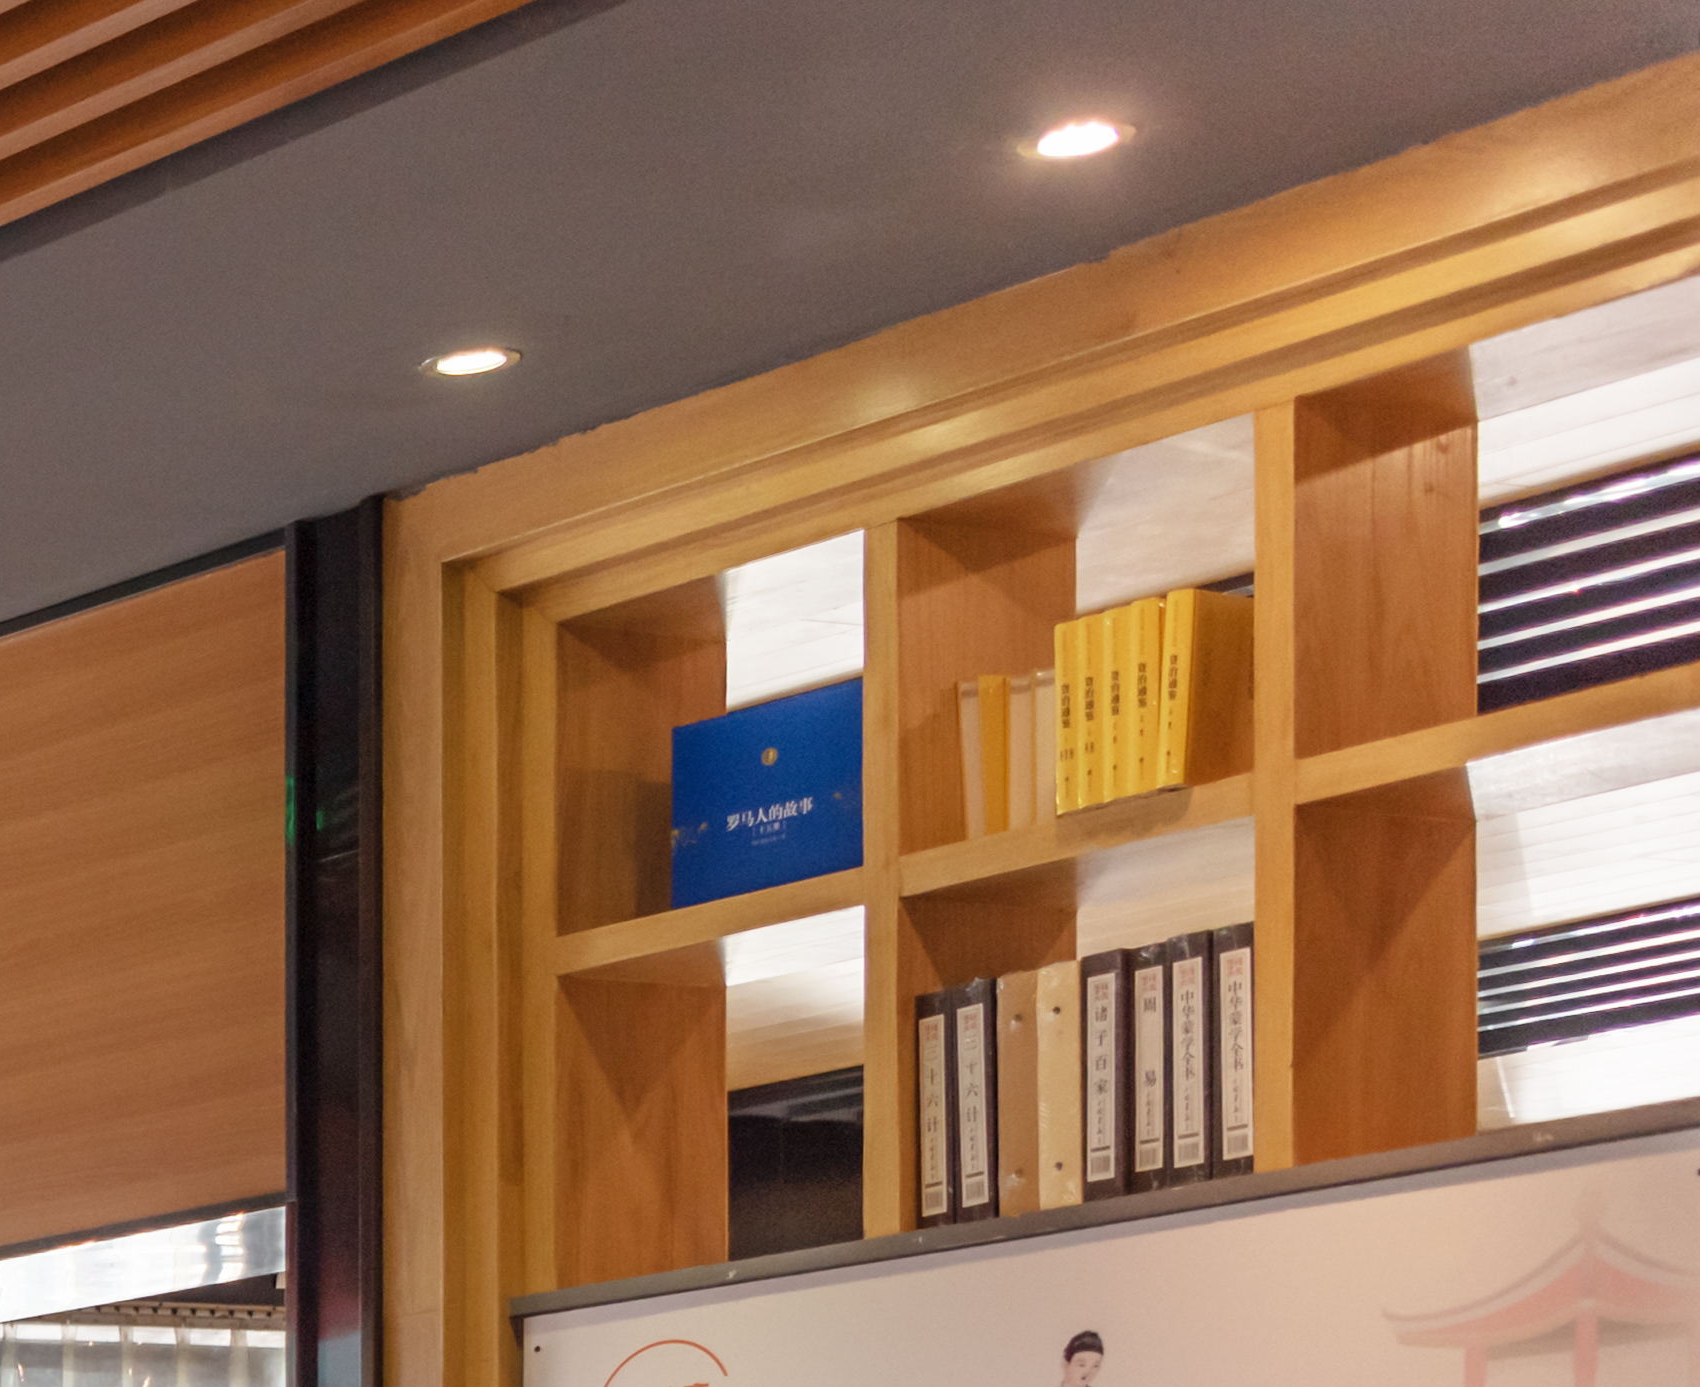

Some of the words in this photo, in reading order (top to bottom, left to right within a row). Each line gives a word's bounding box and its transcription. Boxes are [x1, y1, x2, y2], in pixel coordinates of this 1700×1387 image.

[726, 796, 814, 832] 罗马人的故事
